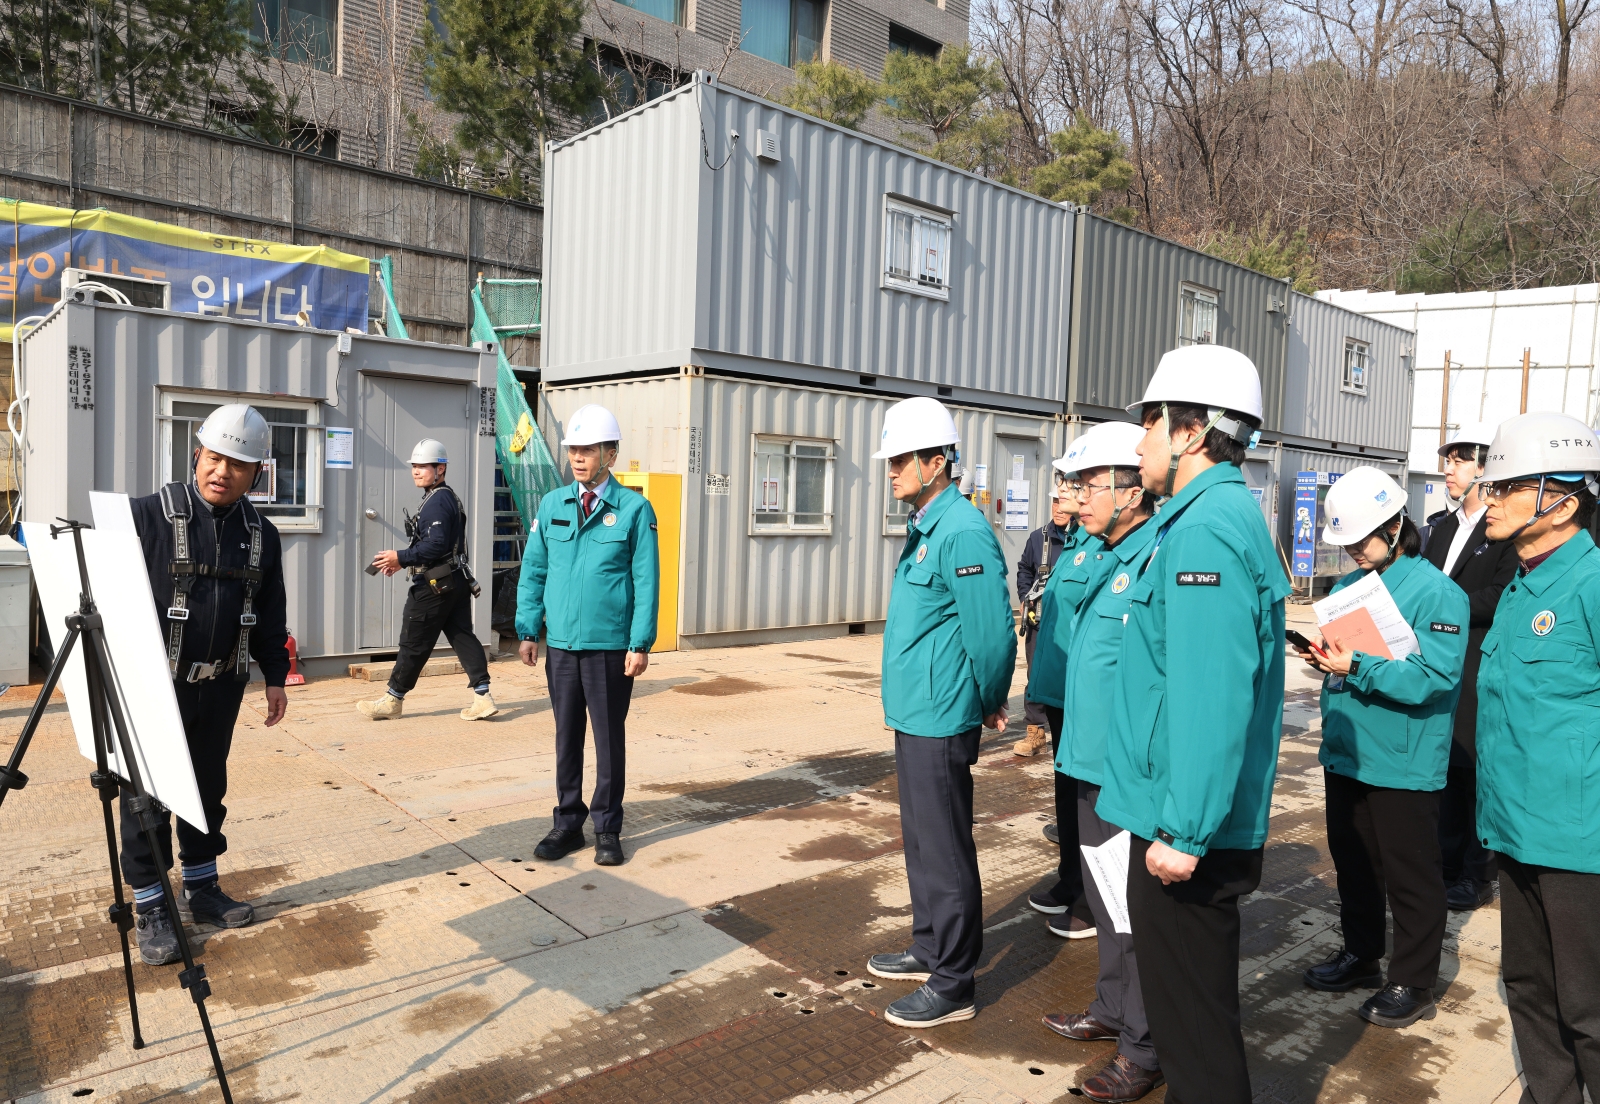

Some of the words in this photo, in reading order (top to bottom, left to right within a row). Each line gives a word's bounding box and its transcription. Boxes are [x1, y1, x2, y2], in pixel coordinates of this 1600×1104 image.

[212, 238, 271, 255] STRX
[191, 275, 313, 327] 입니다
[222, 433, 247, 446] STRX
[1549, 438, 1594, 448] STRX
[1485, 454, 1505, 462] STRX
[178, 546, 186, 559] K2
[251, 555, 259, 567] K2
[967, 566, 981, 574] 강남구
[1180, 574, 1194, 583] 서울
[1195, 574, 1217, 583] 강남구
[170, 646, 179, 660] K2
[239, 650, 246, 663] K2
